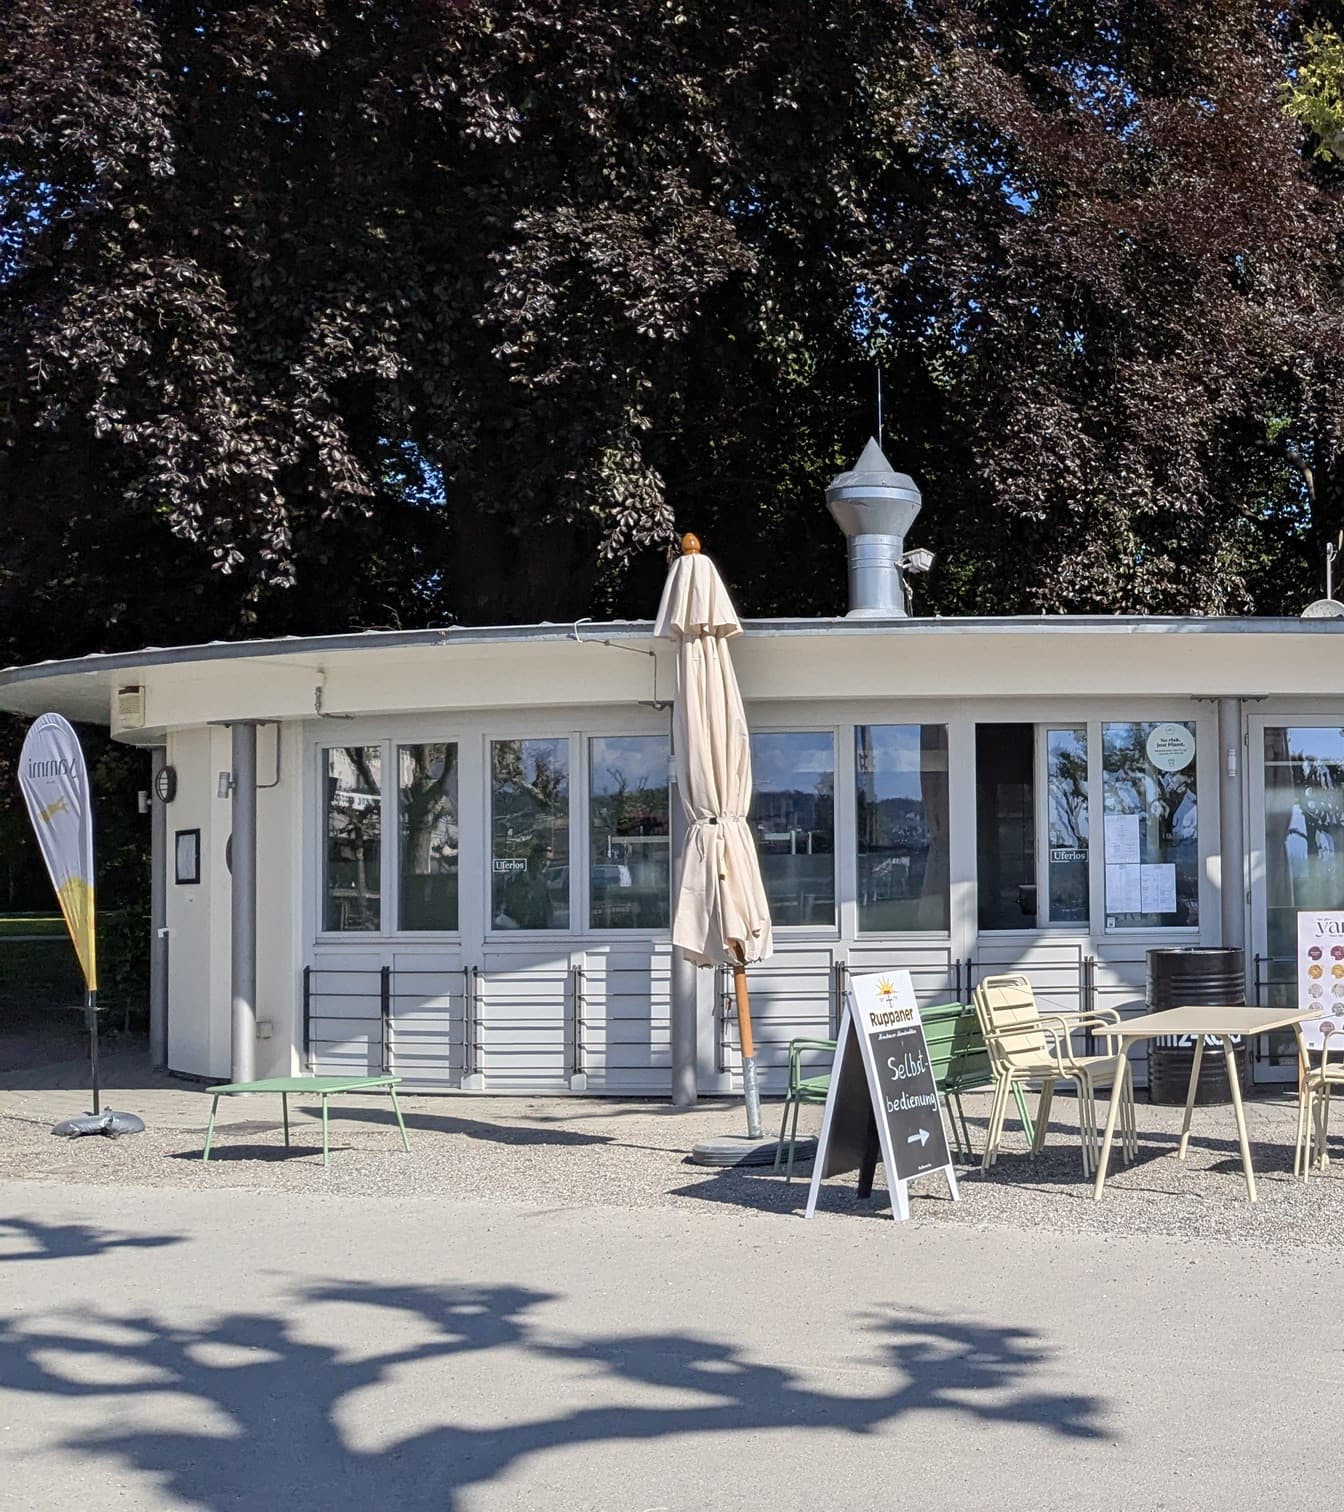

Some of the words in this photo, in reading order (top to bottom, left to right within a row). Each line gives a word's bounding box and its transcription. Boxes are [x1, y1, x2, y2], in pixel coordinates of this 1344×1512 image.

[495, 861, 524, 869] Uferlos
[1054, 851, 1086, 860] Uferlos
[869, 1008, 914, 1027] Ruppaner
[887, 1050, 929, 1080] Selbst-
[886, 1091, 938, 1113] bedienung
